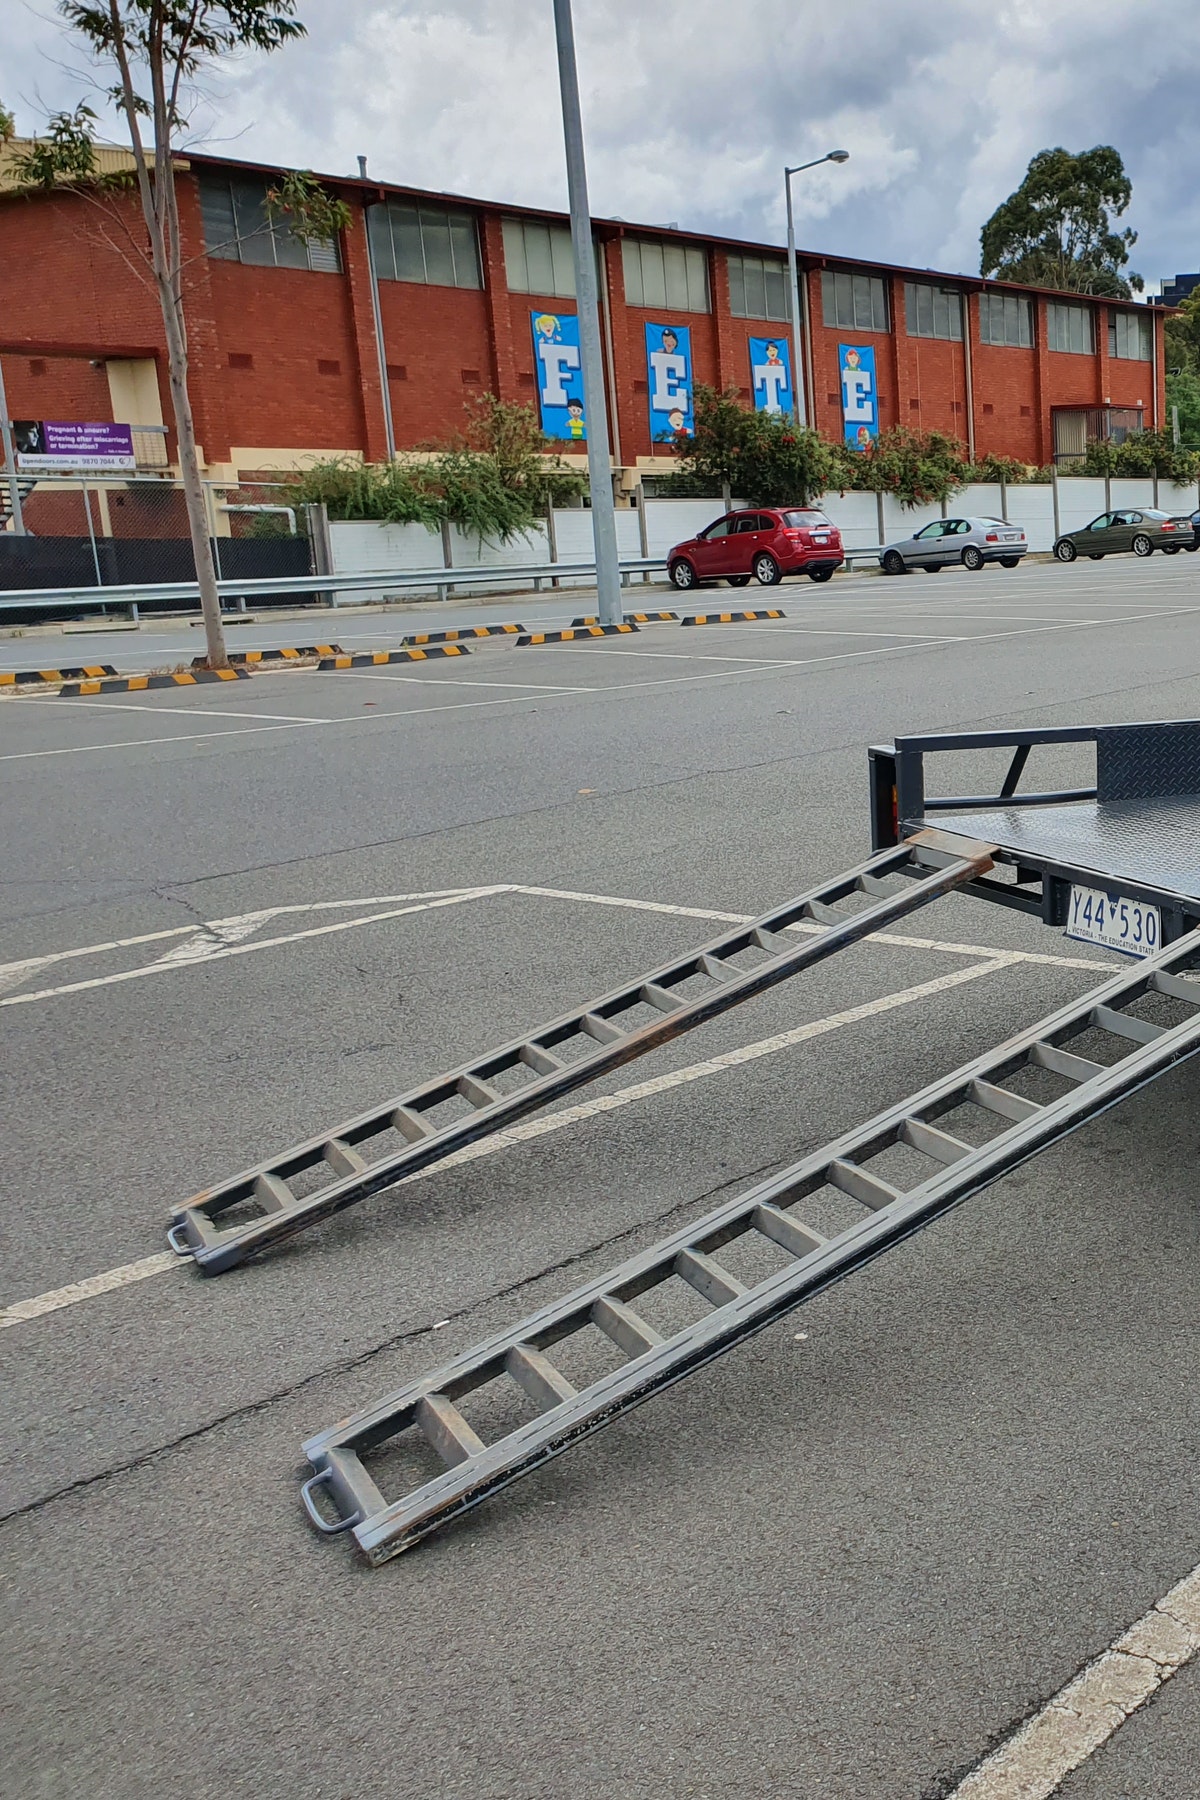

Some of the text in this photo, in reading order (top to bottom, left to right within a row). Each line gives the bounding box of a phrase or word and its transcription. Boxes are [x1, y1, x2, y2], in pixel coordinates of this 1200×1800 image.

[539, 343, 874, 423] F E T E
[47, 425, 76, 434] Pregnant
[84, 426, 110, 434] unsure?
[49, 434, 129, 445] Grieving after miscarriage
[58, 442, 99, 450] termination?
[1074, 890, 1156, 946] Y44 530
[1072, 927, 1094, 938] VICTORIA
[1098, 933, 1108, 942] THE
[1109, 936, 1138, 951] EDUCATION
[1138, 945, 1155, 955] STATE
